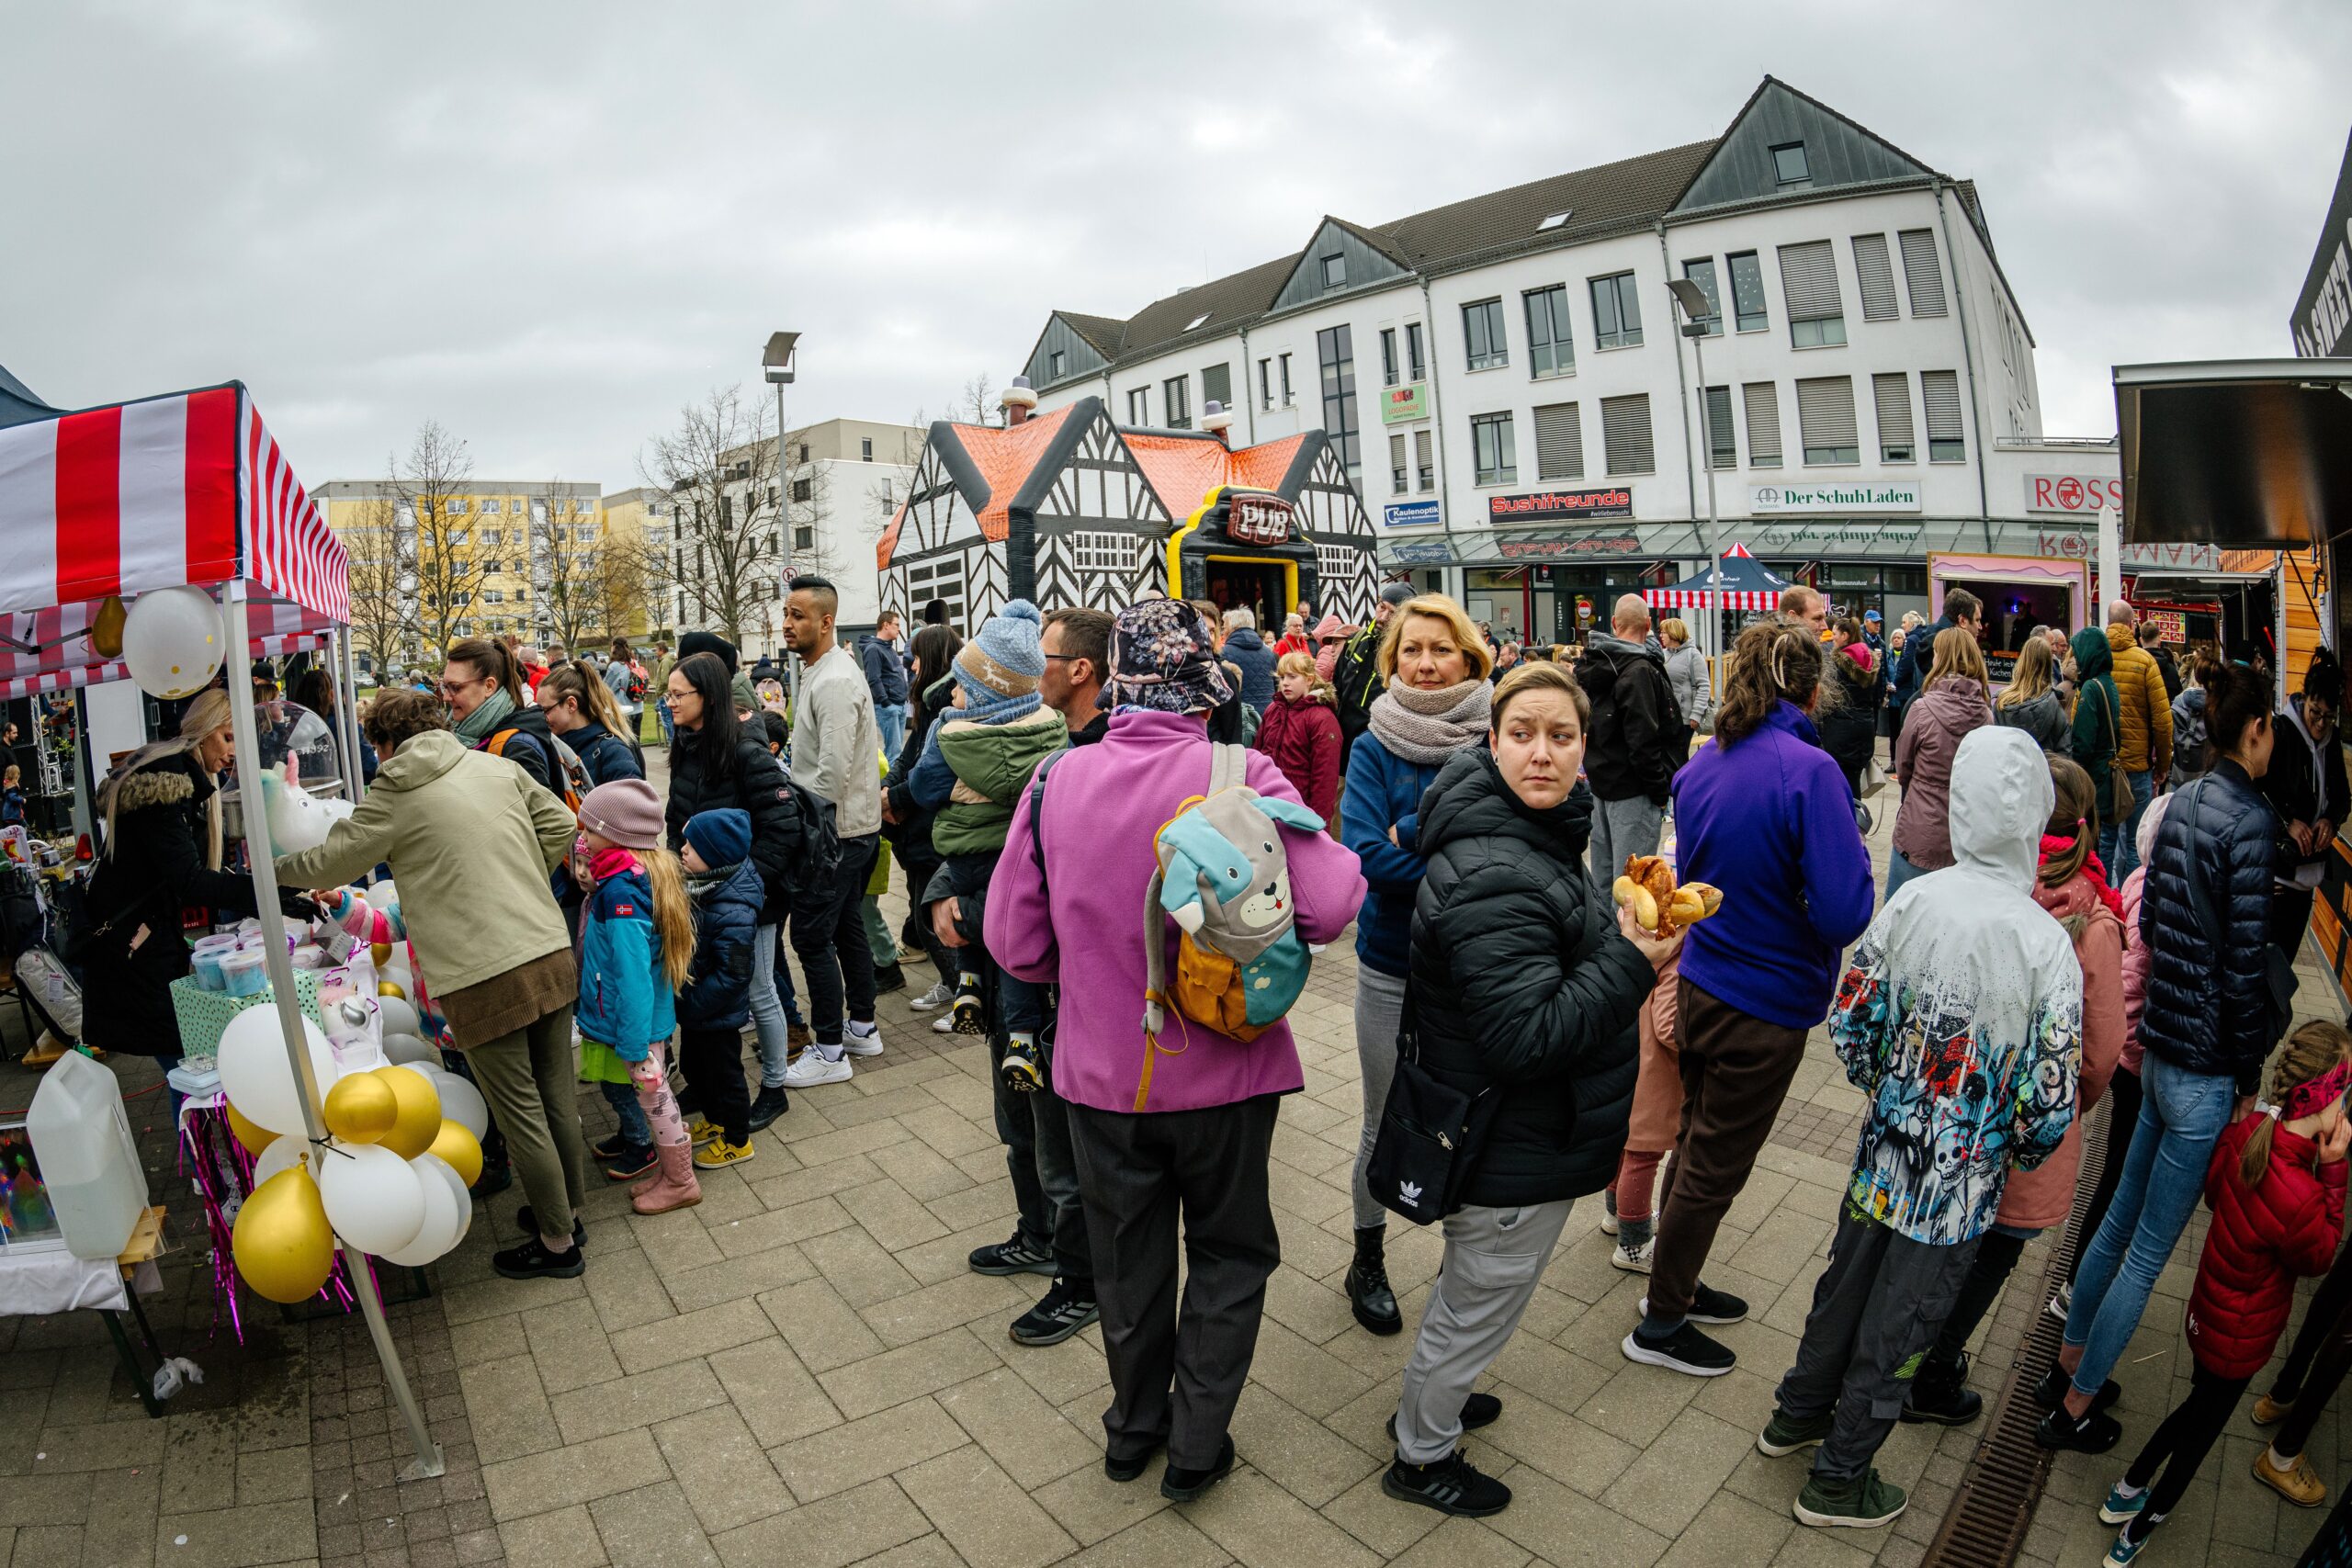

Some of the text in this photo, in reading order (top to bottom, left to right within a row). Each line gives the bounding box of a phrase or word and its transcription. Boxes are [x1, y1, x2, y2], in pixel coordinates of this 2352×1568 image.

[1492, 490, 1630, 513] Sushifreunde
[1784, 491, 1814, 504] Der
[1240, 503, 1288, 537] PUB
[1399, 1194, 1419, 1208] adidas
